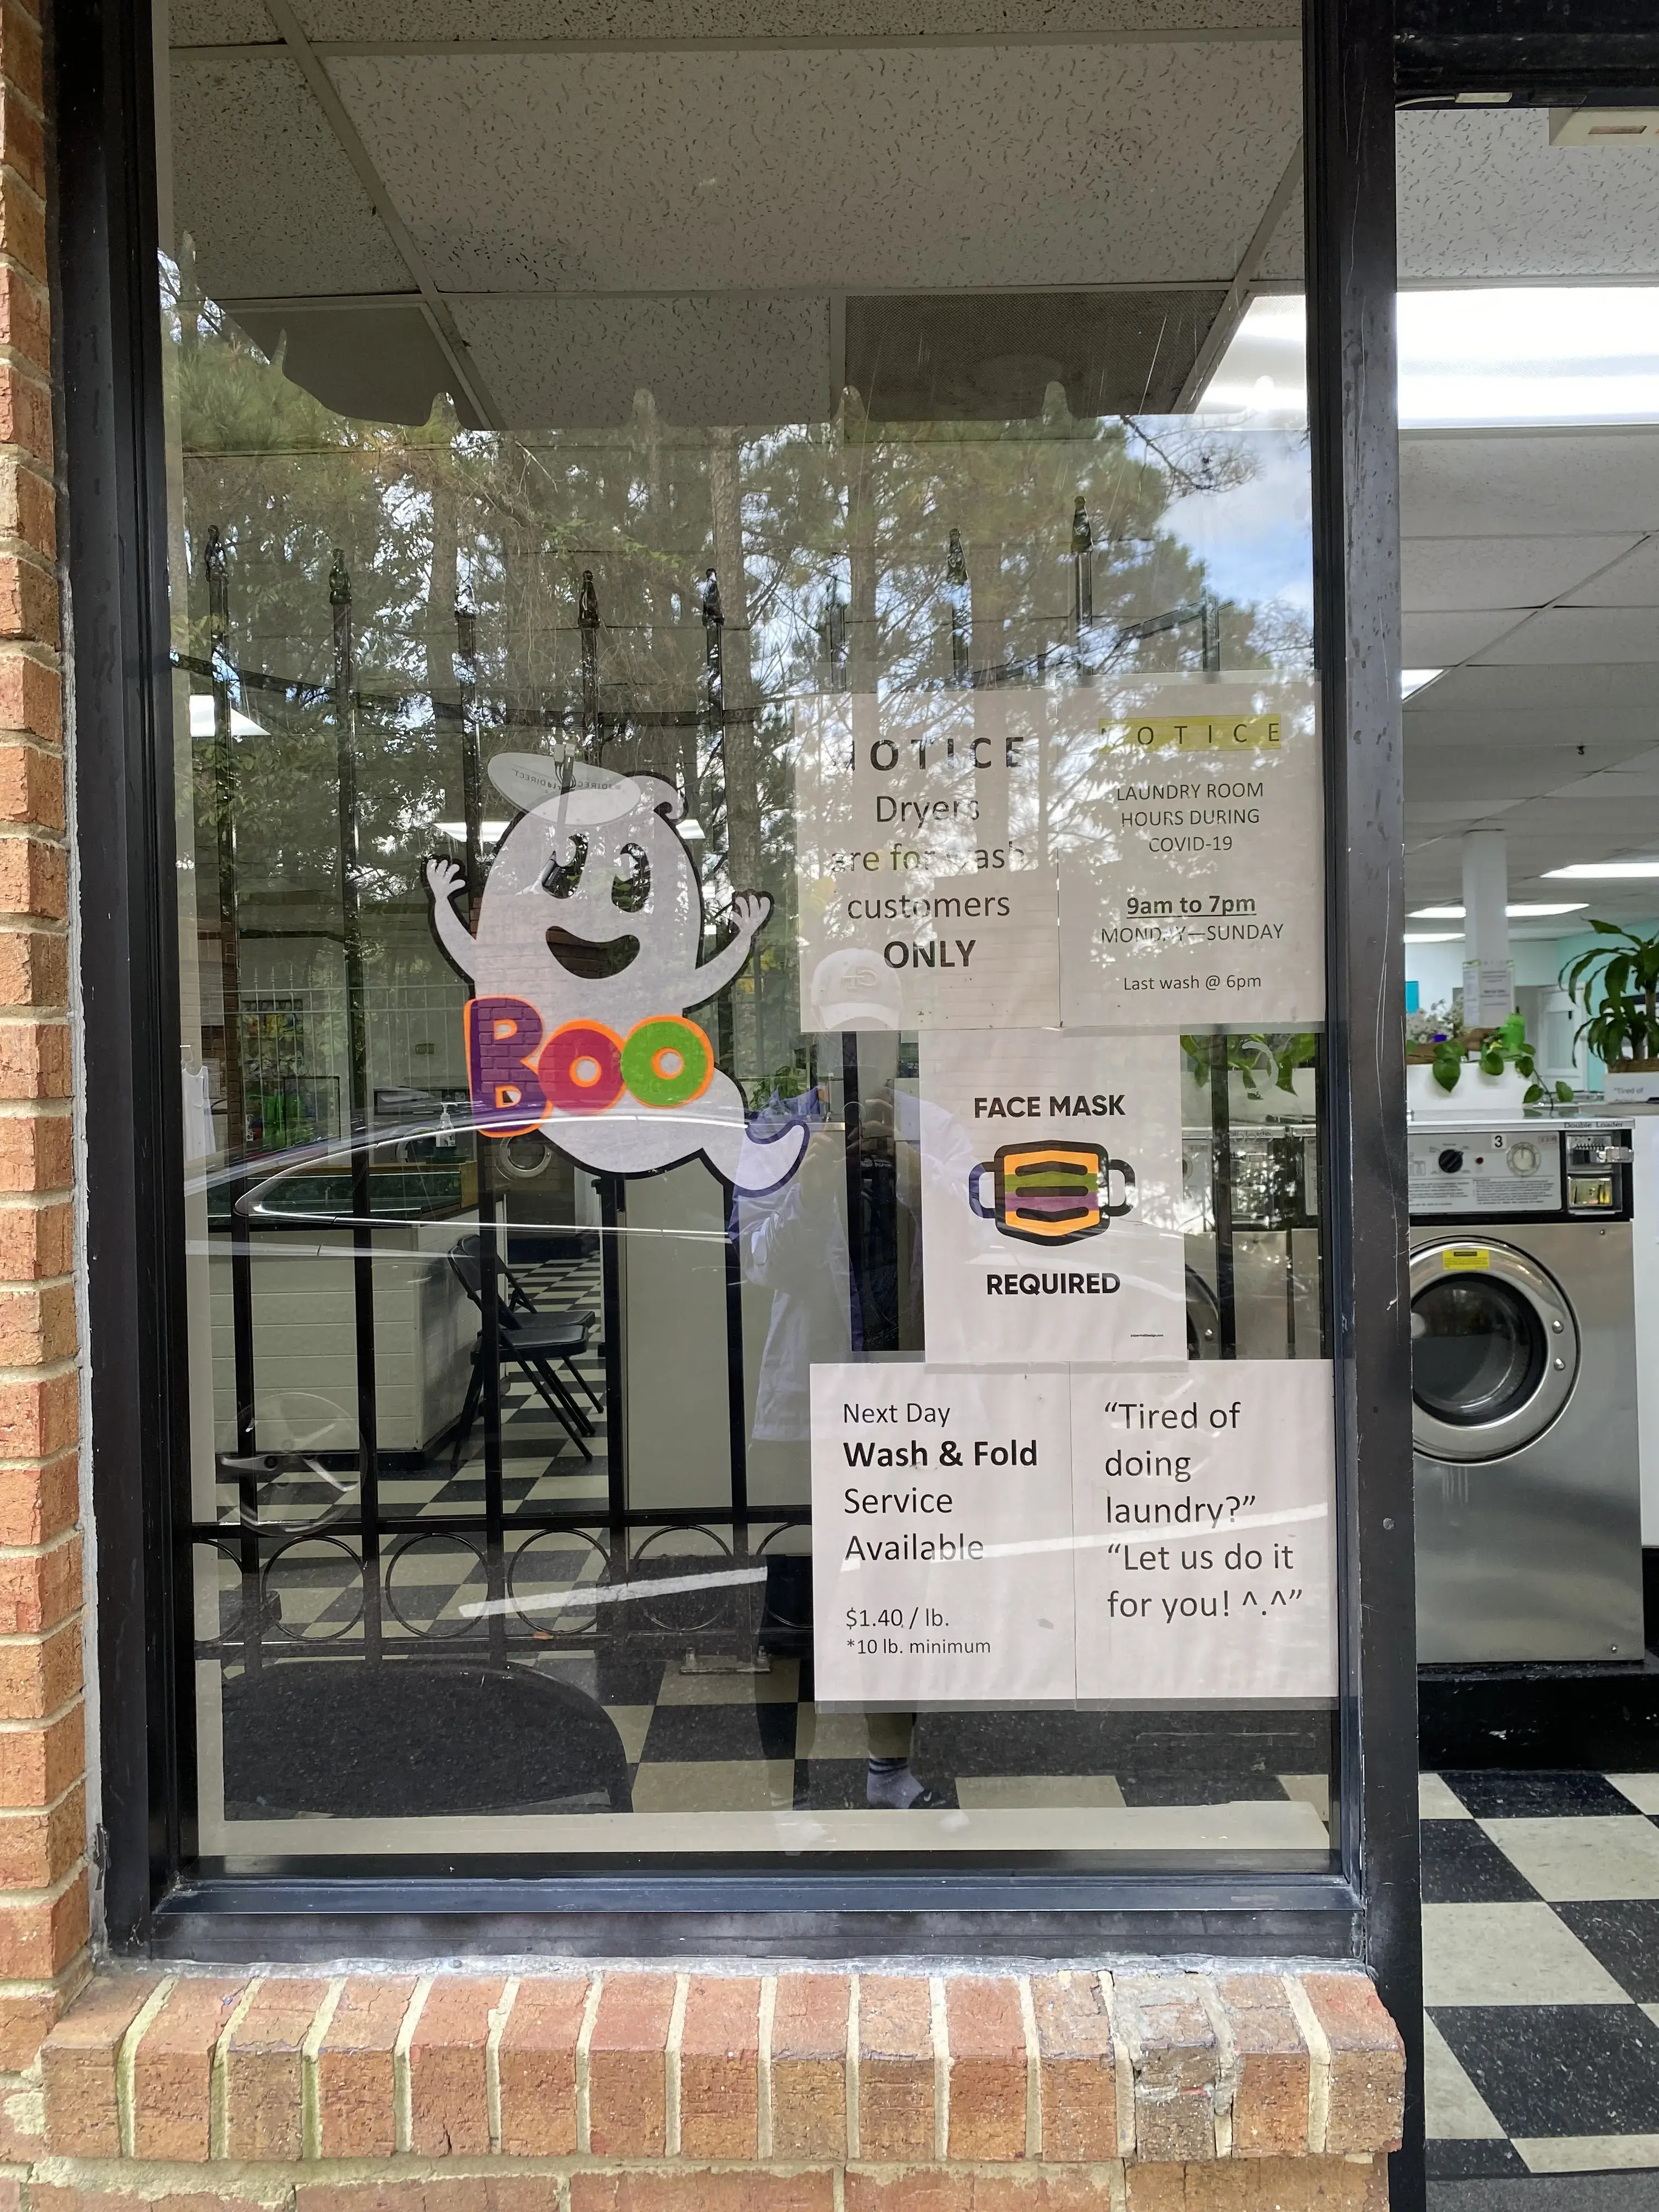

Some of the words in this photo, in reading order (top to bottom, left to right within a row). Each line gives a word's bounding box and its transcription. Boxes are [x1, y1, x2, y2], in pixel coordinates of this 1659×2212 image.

[1116, 783, 1201, 801] LAUNDRY
[1207, 782, 1263, 798] ROOM
[876, 795, 980, 829] Dryers
[1121, 810, 1184, 827] HOURS
[1190, 808, 1260, 825] DURING
[1149, 836, 1233, 852] COVID-19
[848, 895, 1010, 919] customers
[1126, 895, 1173, 916] 9am
[1180, 896, 1202, 914] to
[1209, 895, 1256, 916] 7pm
[884, 940, 977, 968] ONLY
[1124, 977, 1155, 990] Last
[1159, 973, 1200, 990] wash
[1205, 975, 1221, 991] @
[1226, 974, 1261, 991] 6pm
[974, 1096, 1041, 1119] FACE
[1049, 1094, 1126, 1117] MASK
[1494, 1135, 1503, 1148] 3
[986, 1273, 1121, 1296] REQUIRED
[844, 1403, 898, 1423] Next
[907, 1403, 951, 1428] Day
[1104, 1402, 1197, 1429] “Tired
[1210, 1401, 1241, 1429] of
[843, 1441, 928, 1467] Wash
[939, 1440, 963, 1466] &
[974, 1439, 1037, 1466] Fold
[1105, 1449, 1191, 1482] doing
[844, 1487, 953, 1514] Service
[1106, 1496, 1256, 1529] laundry?”
[845, 1533, 984, 1561] Available
[1108, 1543, 1170, 1571] “Let
[1181, 1550, 1213, 1570] us
[1224, 1543, 1262, 1570] do
[1274, 1543, 1294, 1570] it
[846, 1607, 903, 1630] $1.40
[909, 1607, 919, 1630] /
[926, 1608, 949, 1627] lb.
[1107, 1590, 1152, 1617] for
[1161, 1590, 1229, 1624] you!
[883, 1638, 903, 1654] lb.
[910, 1639, 990, 1654] minimum
